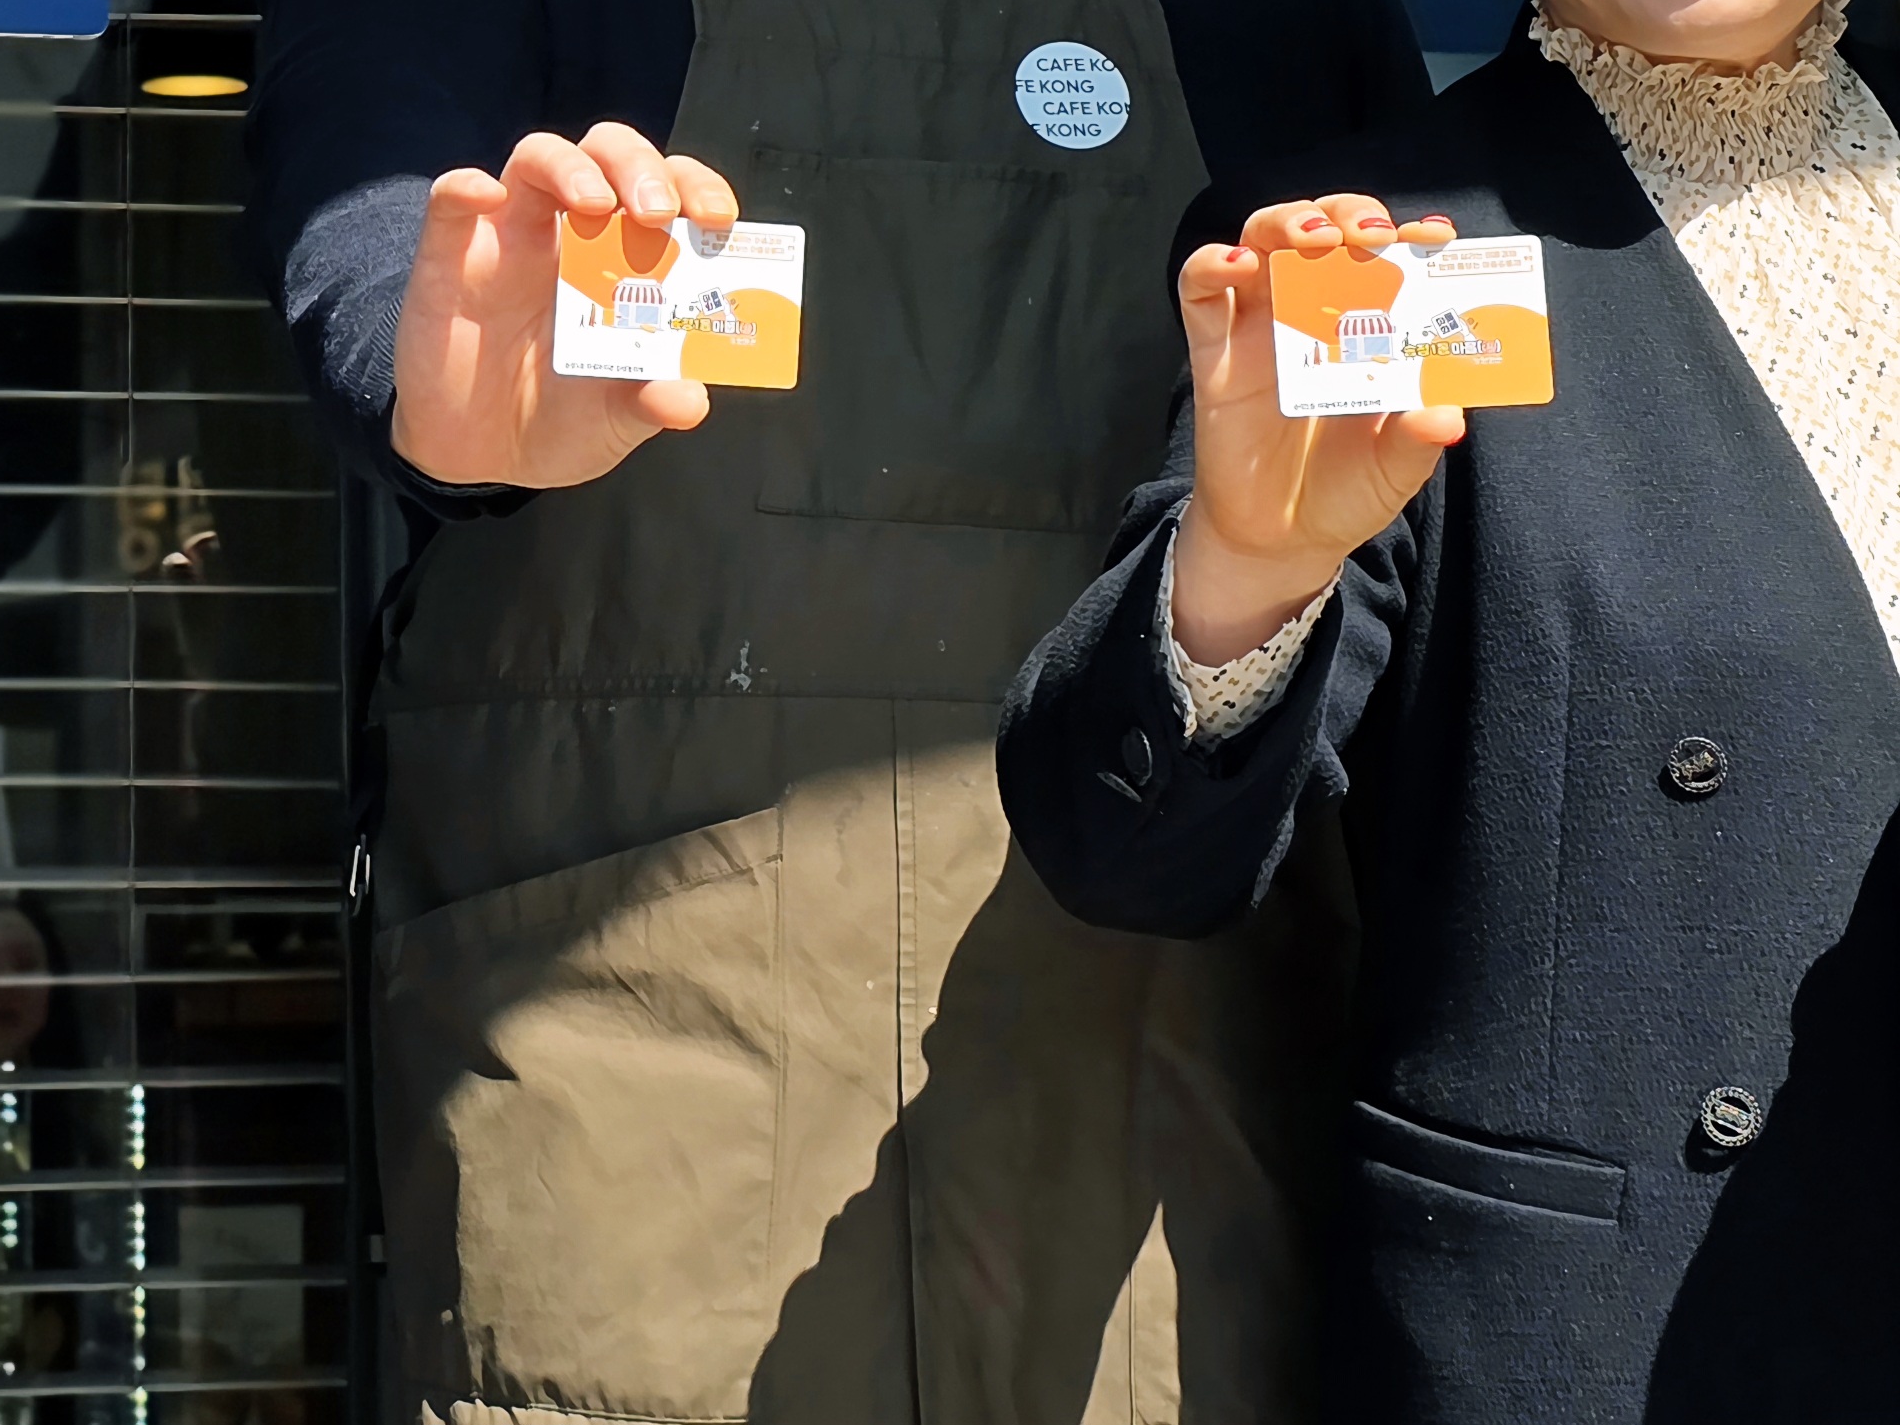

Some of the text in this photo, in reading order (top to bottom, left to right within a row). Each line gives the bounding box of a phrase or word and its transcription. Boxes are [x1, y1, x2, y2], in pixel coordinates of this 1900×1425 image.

[1036, 58, 1116, 72] CAFE KO
[1039, 79, 1095, 93] KONG
[1042, 101, 1093, 115] CAFE
[1045, 123, 1102, 137] KONG
